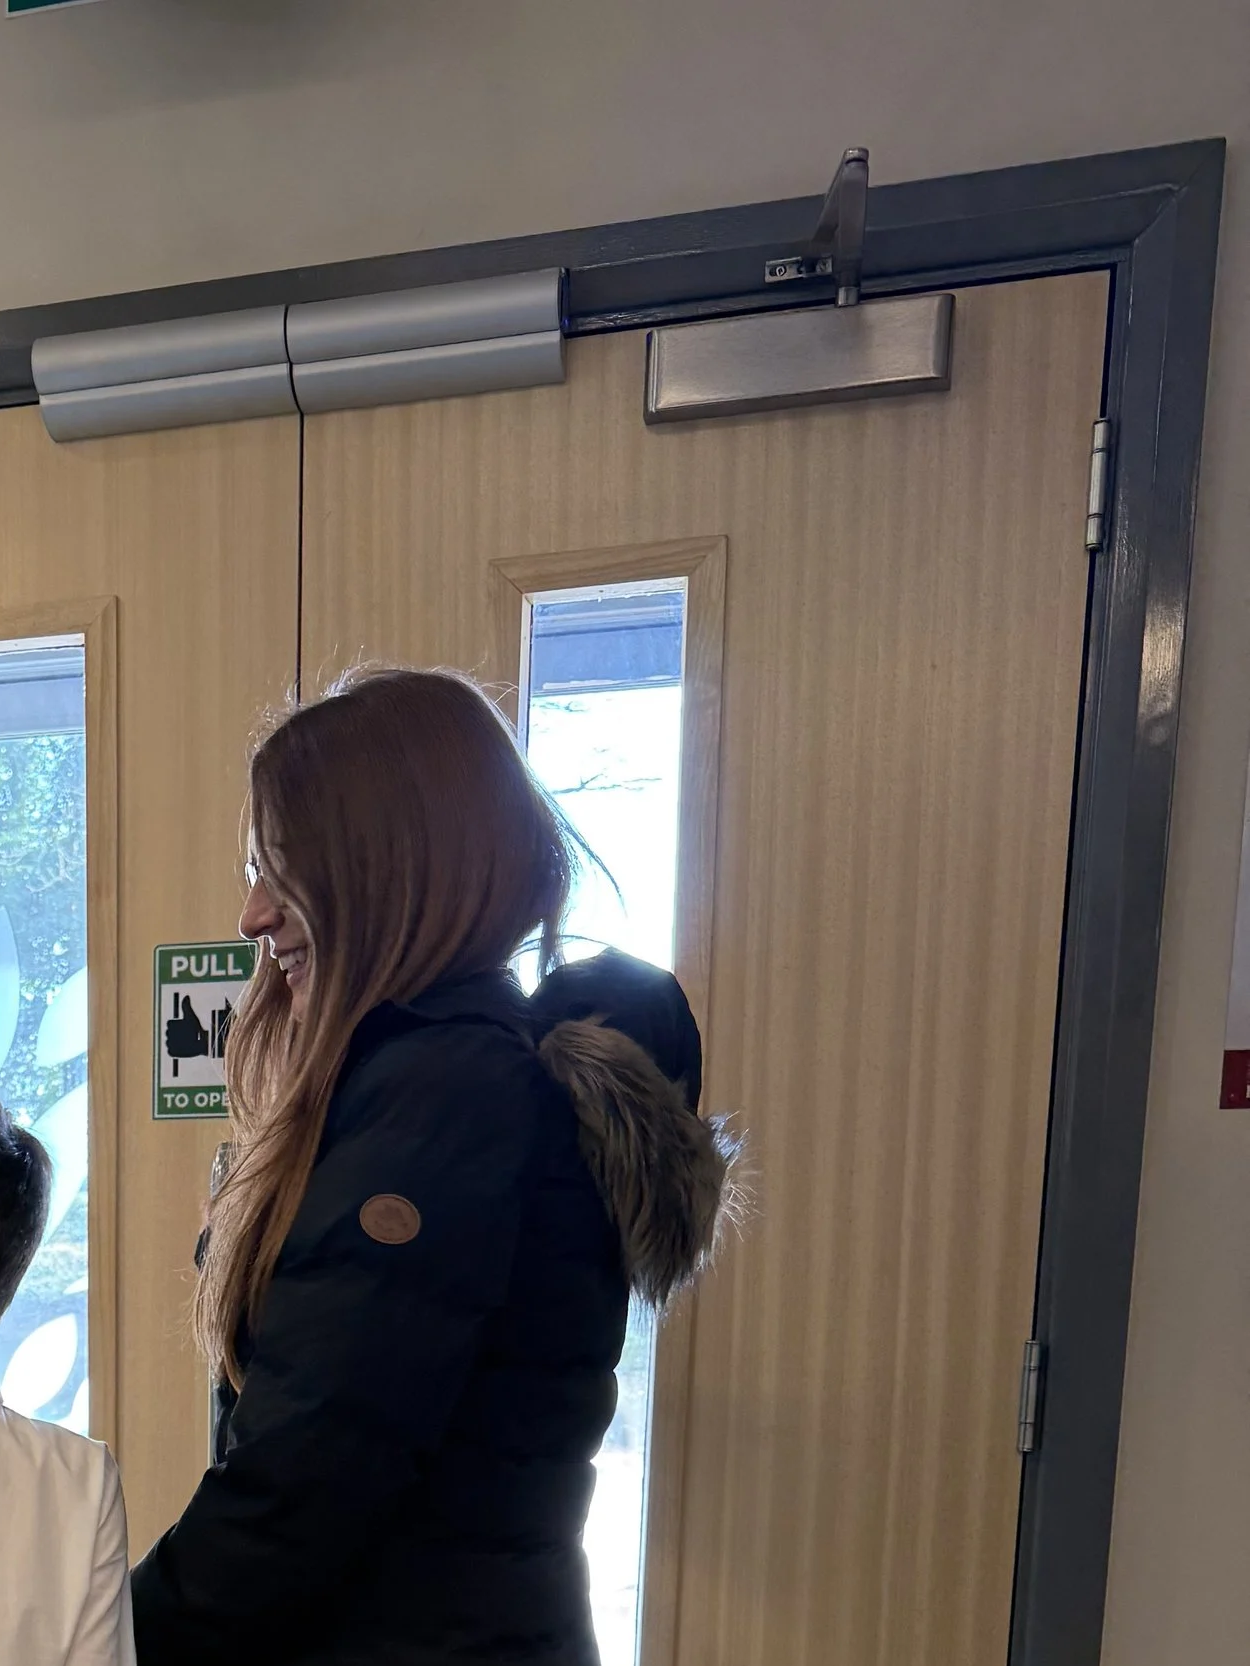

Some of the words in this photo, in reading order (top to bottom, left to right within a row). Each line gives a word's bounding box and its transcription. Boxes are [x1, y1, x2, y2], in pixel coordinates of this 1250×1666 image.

[171, 953, 243, 979] PULL
[163, 1093, 189, 1108] TO
[195, 1092, 230, 1107] OPE
